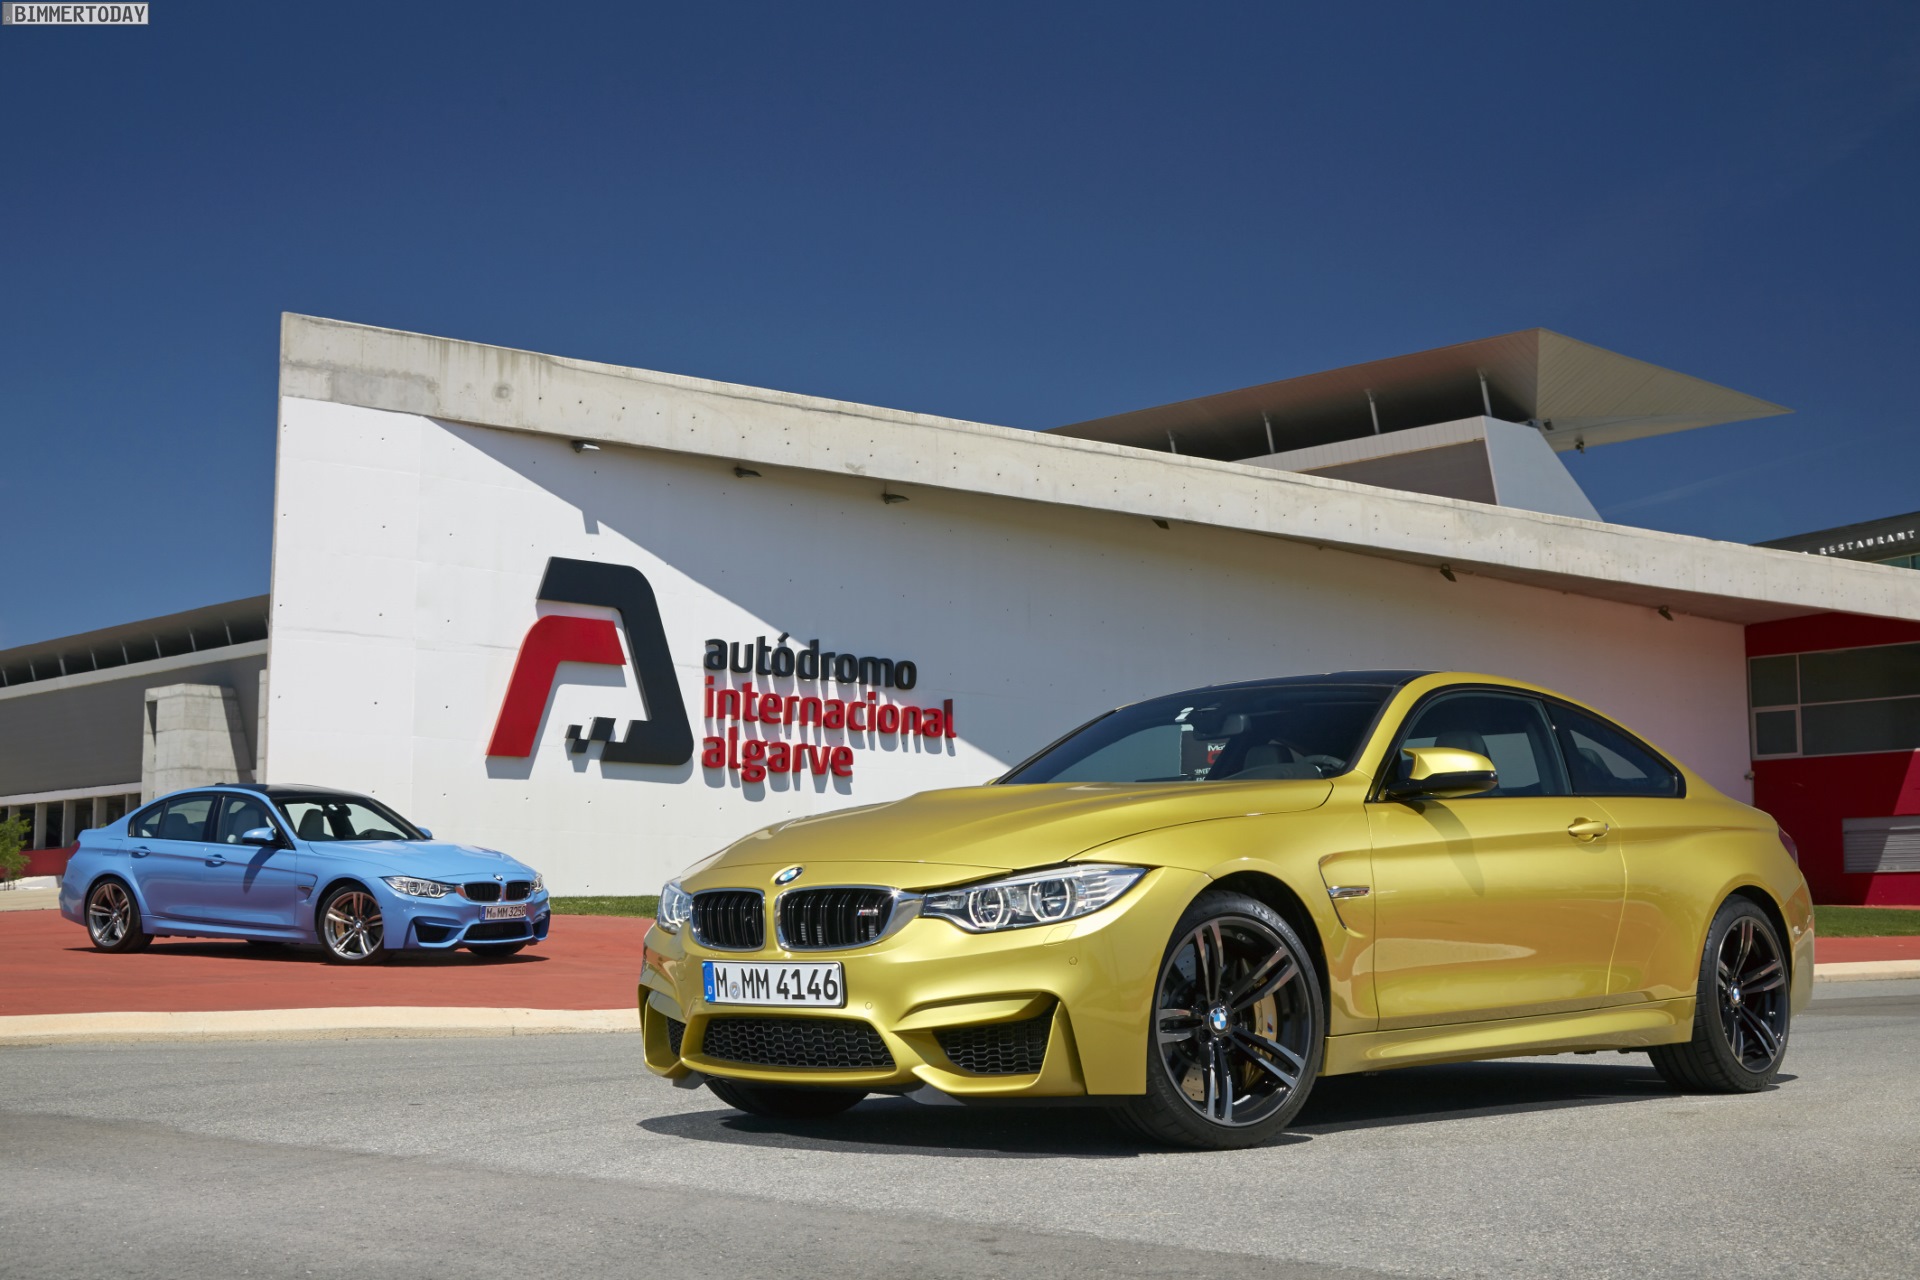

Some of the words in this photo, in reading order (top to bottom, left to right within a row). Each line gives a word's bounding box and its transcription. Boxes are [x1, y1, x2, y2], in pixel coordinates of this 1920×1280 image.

[1819, 530, 1916, 555] RESTAURANT
[703, 632, 917, 690] autódromo
[703, 675, 957, 739] internacional
[701, 726, 854, 783] algarve
[486, 907, 493, 918] M
[497, 908, 508, 918] MM
[715, 967, 729, 998] M
[741, 968, 770, 999] MM
[776, 968, 839, 1000] 4146
